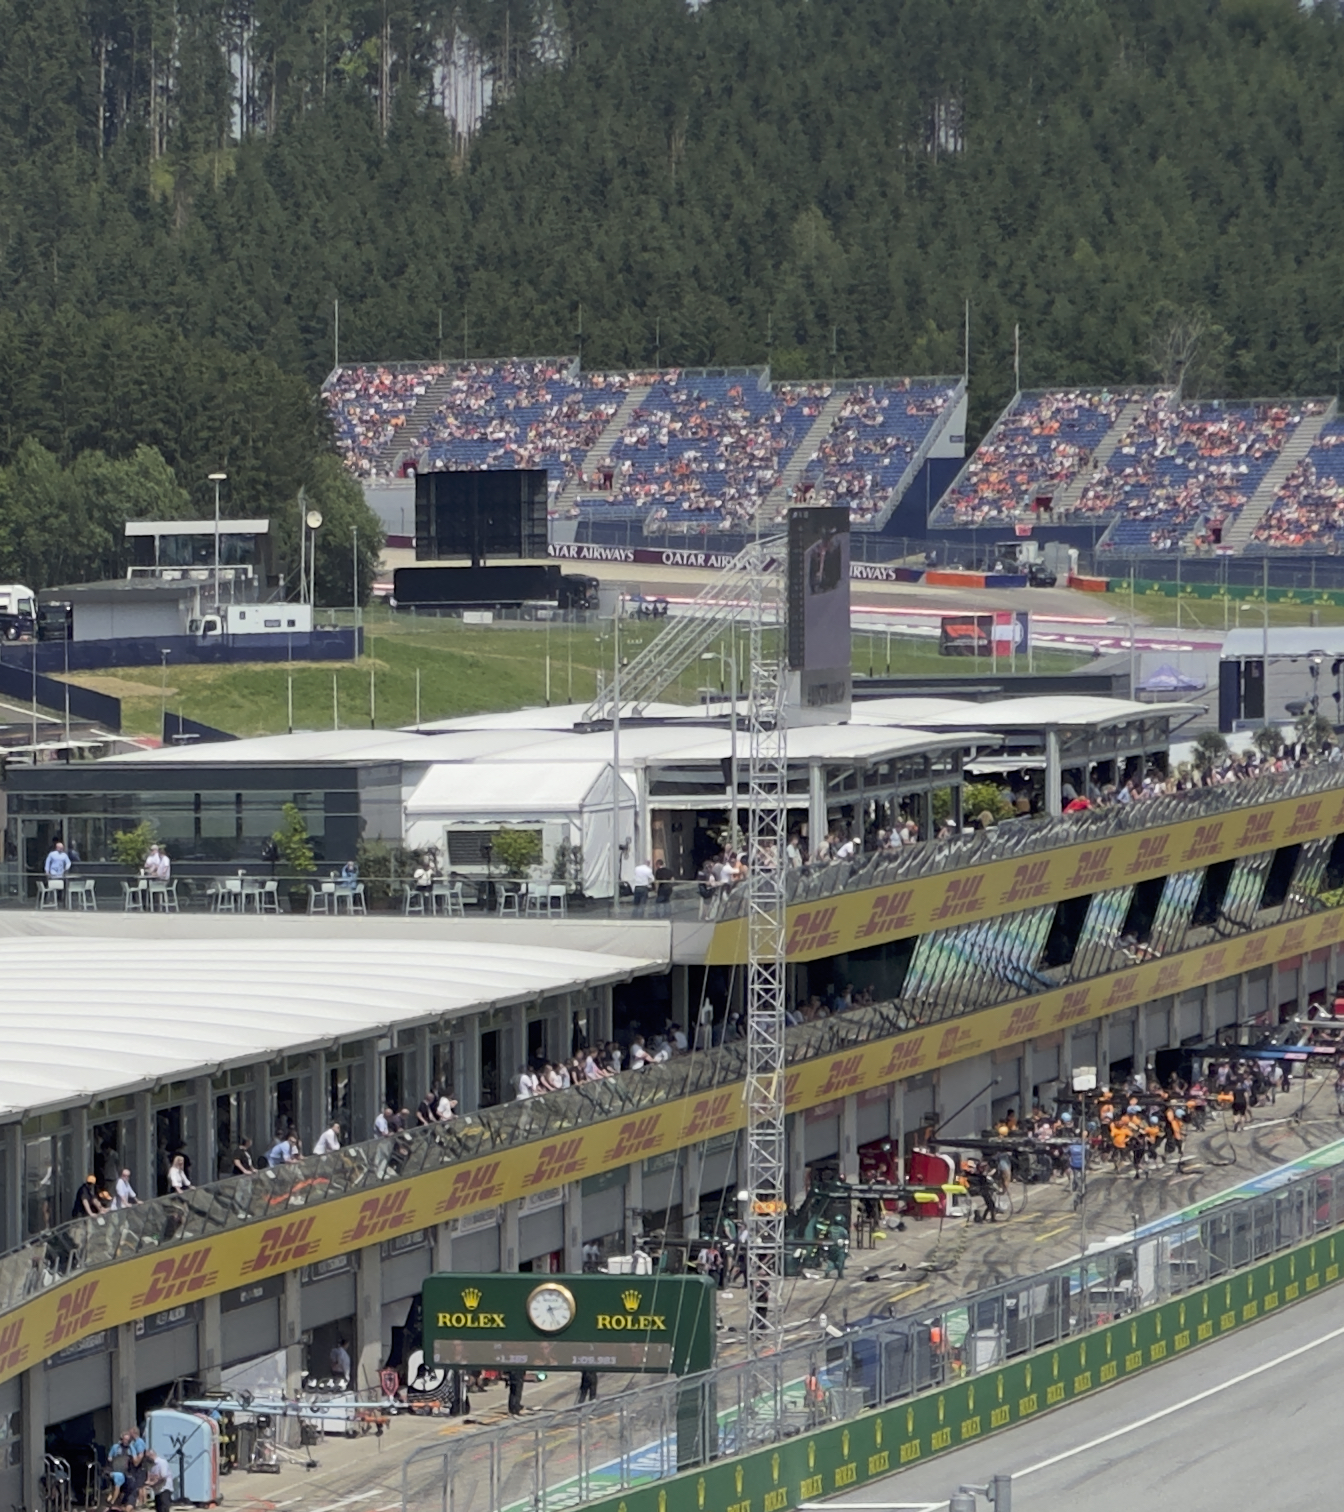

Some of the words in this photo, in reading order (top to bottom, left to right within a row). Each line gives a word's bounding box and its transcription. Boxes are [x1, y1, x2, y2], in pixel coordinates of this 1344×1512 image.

[547, 544, 578, 559] ATAR
[580, 546, 635, 562] AIRWAYS
[662, 551, 706, 567] QATAR
[1007, 860, 1051, 903] DHL
[1069, 846, 1112, 888] DHL
[865, 890, 914, 938] DHL
[938, 874, 986, 921] DHL
[822, 1054, 865, 1095] DHL
[884, 1036, 924, 1078] DHL
[610, 1113, 662, 1160] DHL
[686, 1093, 733, 1136] DHL
[529, 1138, 580, 1185] DHL
[444, 1160, 499, 1211] DHL
[348, 1188, 410, 1242] DHL
[246, 1216, 317, 1272] DHL
[140, 1246, 214, 1307] DHL
[50, 1281, 102, 1344] DHL
[437, 1312, 506, 1328] ROLEX
[597, 1315, 666, 1331] ROLEX
